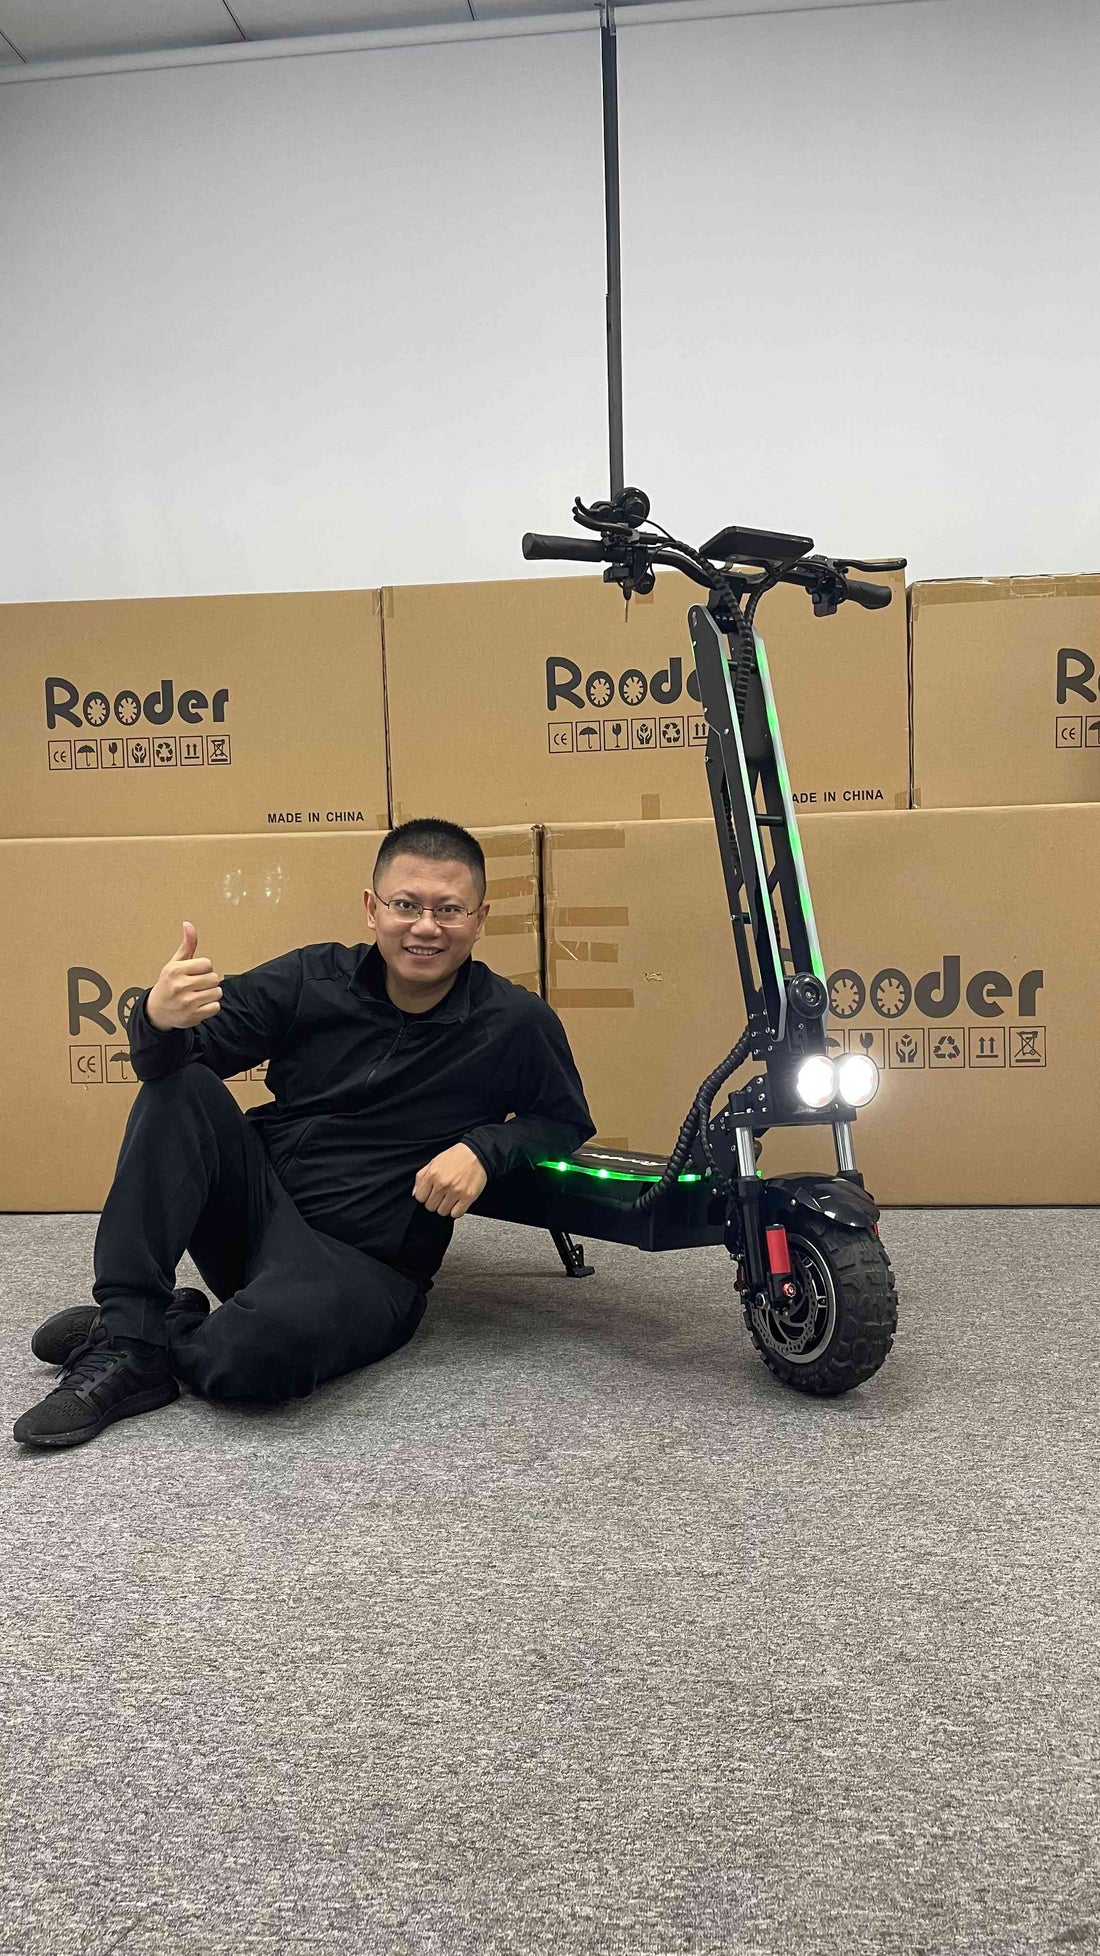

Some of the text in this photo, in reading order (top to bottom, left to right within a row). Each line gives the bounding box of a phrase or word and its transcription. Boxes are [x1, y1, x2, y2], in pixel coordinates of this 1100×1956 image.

[45, 677, 229, 730] Rooder
[792, 789, 884, 803] ADE IN CHINA
[267, 811, 364, 823] MADE IN CHINA
[826, 955, 1044, 1019] ooder
